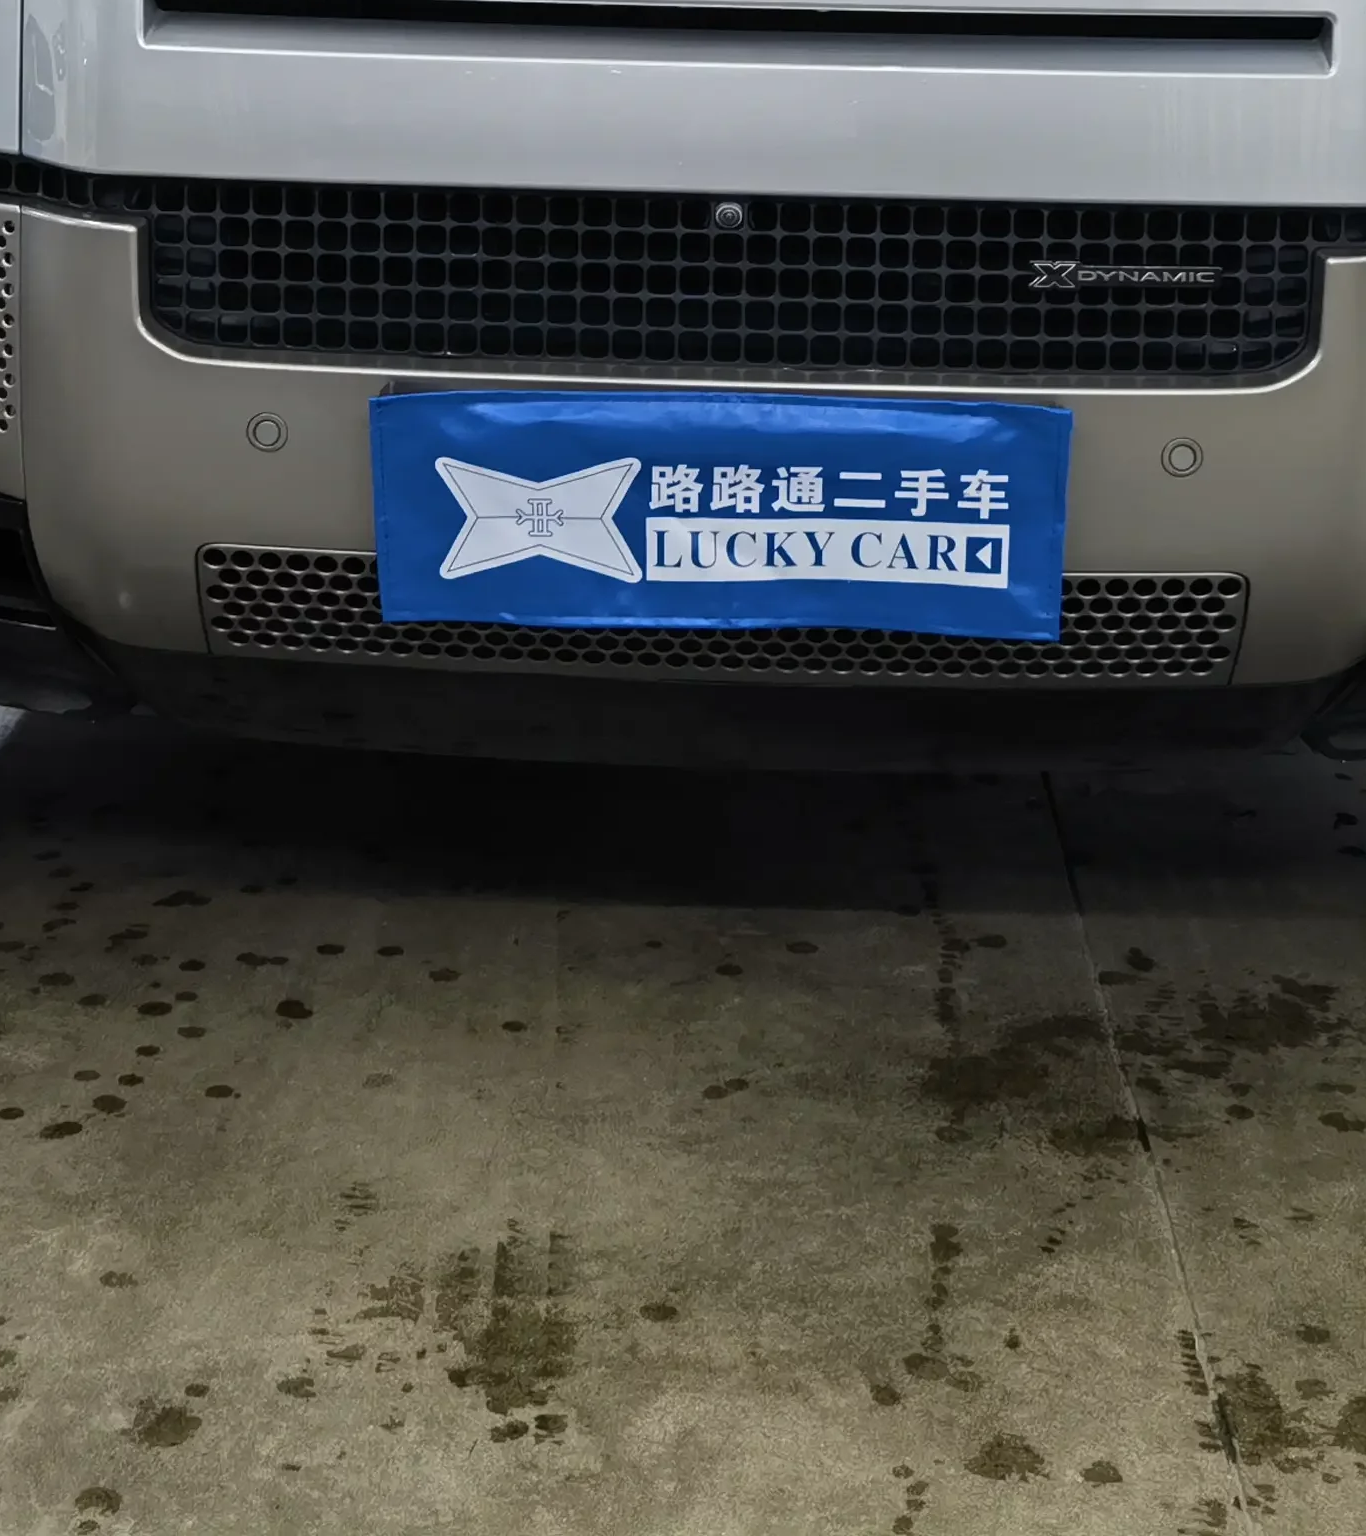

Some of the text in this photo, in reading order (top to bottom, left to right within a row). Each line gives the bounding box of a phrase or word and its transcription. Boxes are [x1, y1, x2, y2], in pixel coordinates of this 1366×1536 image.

[1077, 270, 1215, 283] DYNAMIC
[648, 465, 1010, 519] 路路通二手车
[651, 529, 958, 573] LUCKY CAR
